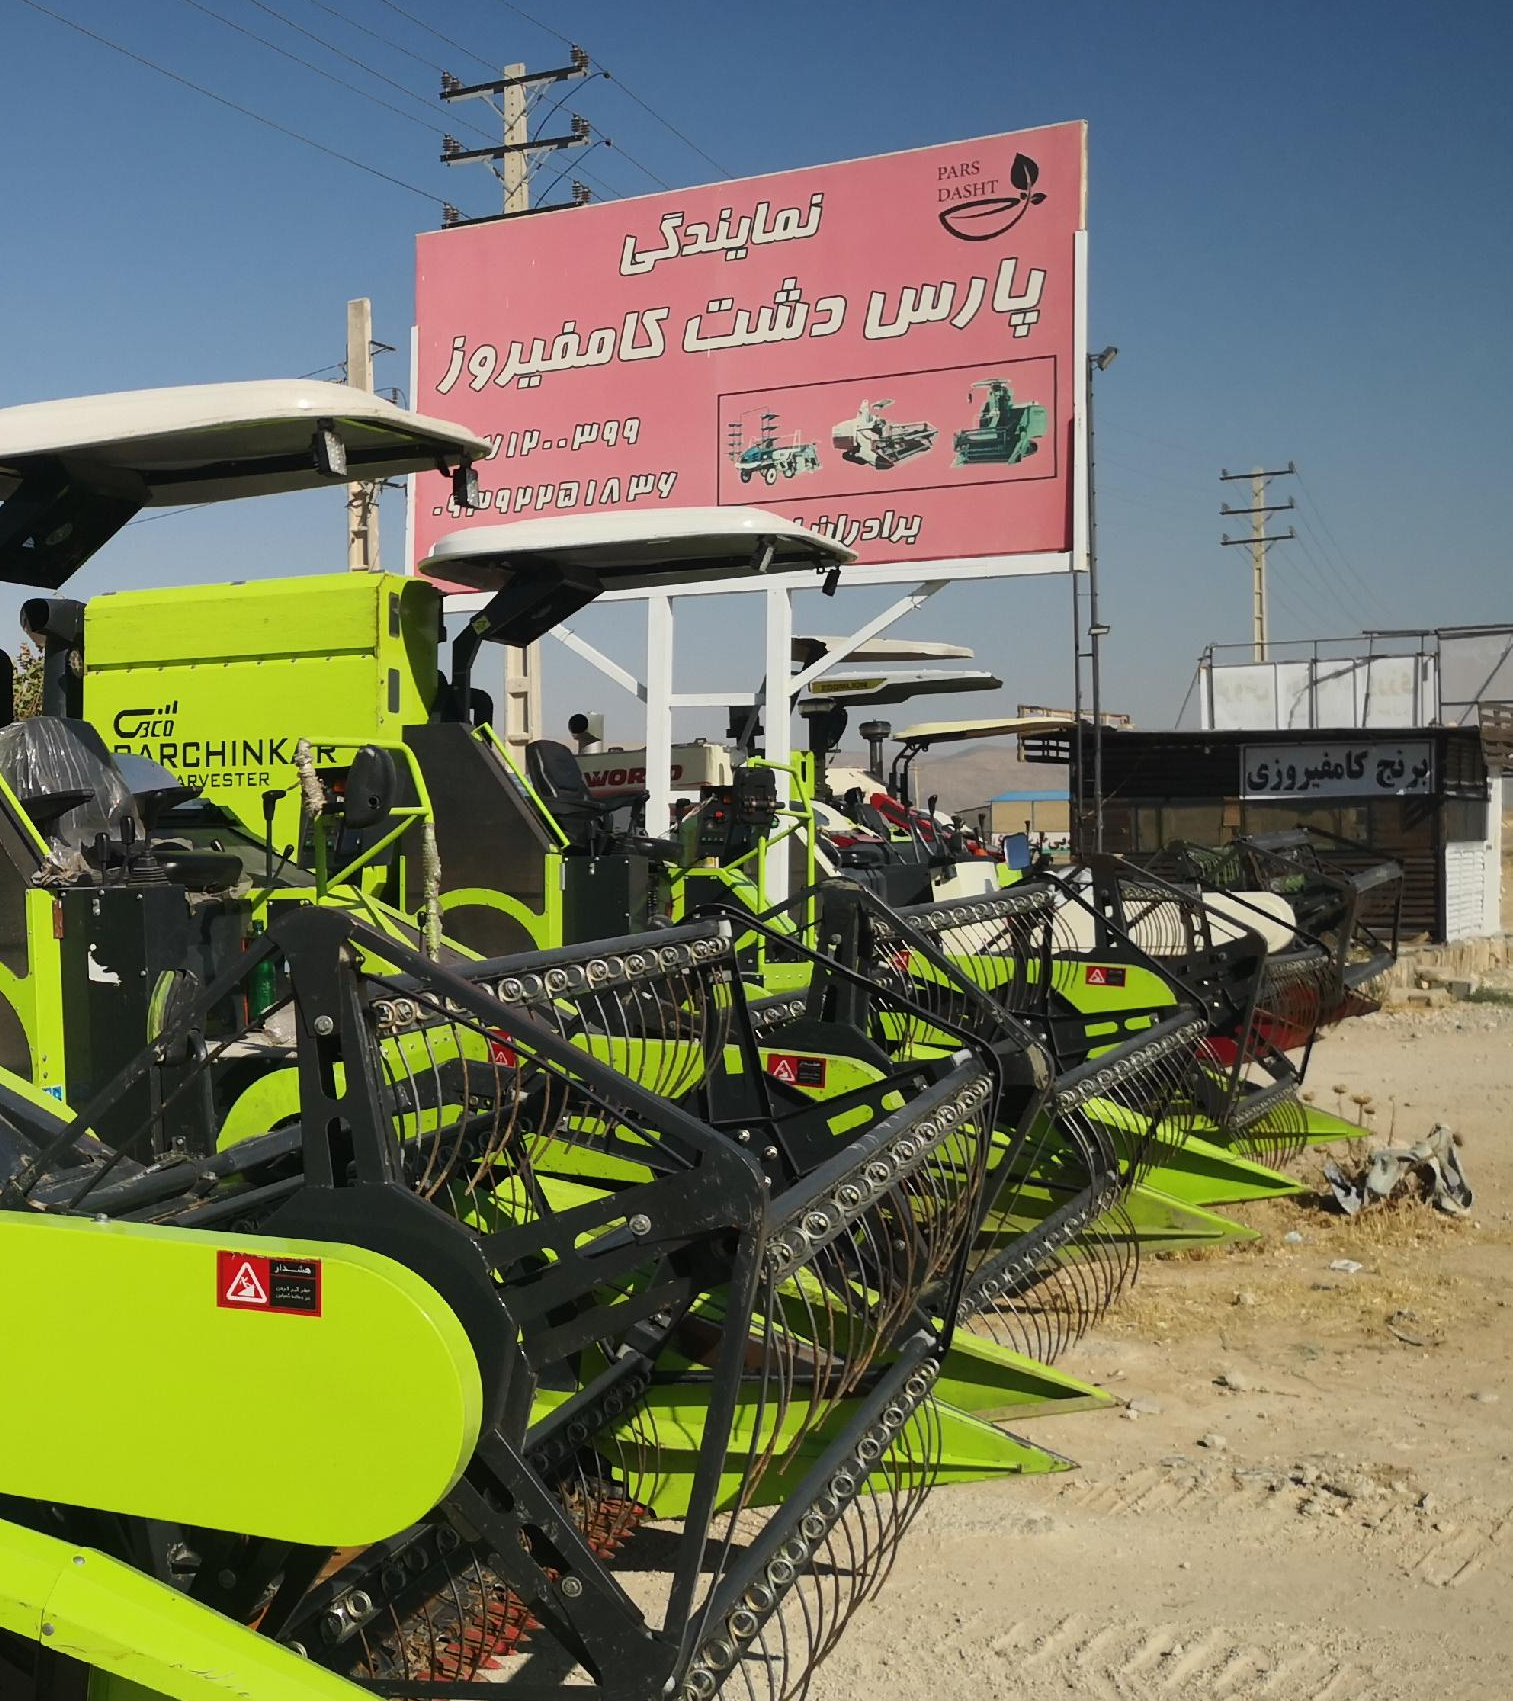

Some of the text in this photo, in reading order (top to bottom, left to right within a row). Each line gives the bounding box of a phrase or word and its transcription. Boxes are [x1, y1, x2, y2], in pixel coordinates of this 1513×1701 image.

[937, 160, 981, 181] PARS
[937, 180, 999, 202] DASHT
[619, 193, 824, 276] نمایندگی
[436, 257, 1046, 395] پارس دشت کامفیروز
[584, 765, 683, 787] WORD
[1248, 750, 1430, 791] برنج کامفیروزی
